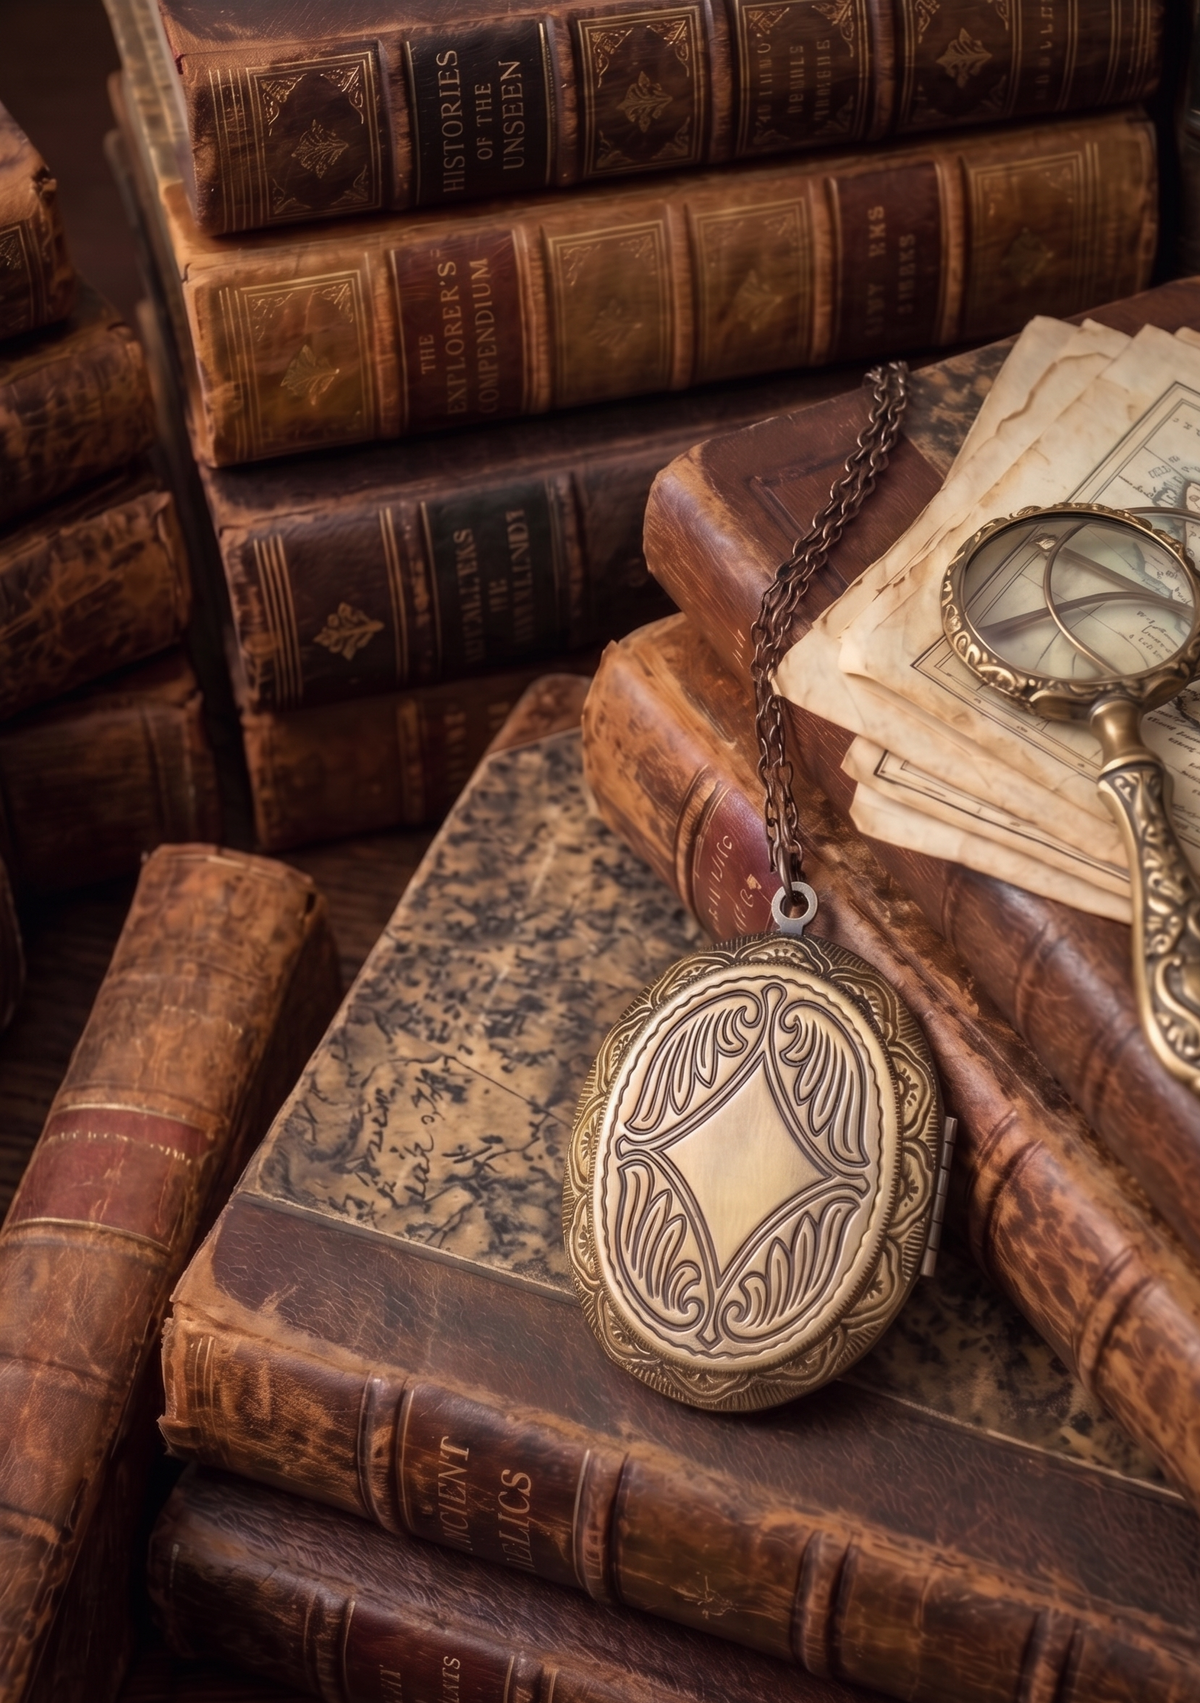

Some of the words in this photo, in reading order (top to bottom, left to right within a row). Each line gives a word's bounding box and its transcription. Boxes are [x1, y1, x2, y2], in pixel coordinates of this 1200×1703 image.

[435, 49, 465, 193] HISTORIES
[474, 82, 493, 127] THE
[476, 137, 494, 161] OF
[497, 61, 526, 170] UNSEEN
[418, 334, 436, 375] THE
[436, 260, 468, 415] EXPLORER'S
[469, 257, 500, 414] COMPENDIUM
[497, 1468, 537, 1573] ELICS
